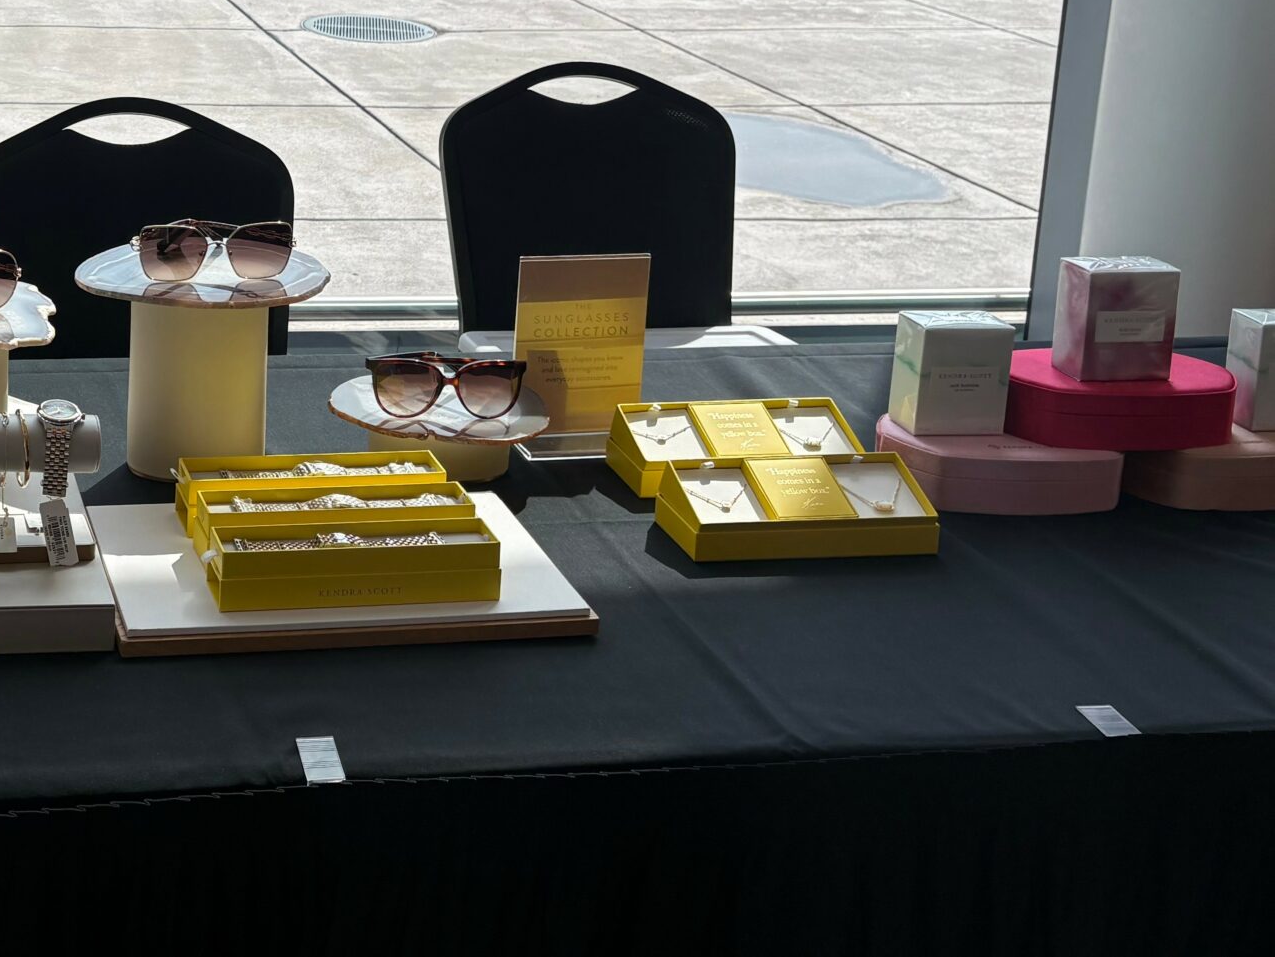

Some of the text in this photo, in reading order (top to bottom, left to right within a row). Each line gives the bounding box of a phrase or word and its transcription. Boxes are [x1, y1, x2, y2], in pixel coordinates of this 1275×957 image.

[533, 312, 629, 324] SUNGLASSES
[533, 325, 628, 338] COLLECTION
[781, 487, 808, 497] yellow
[318, 587, 403, 597] KENDRA SCOTT
